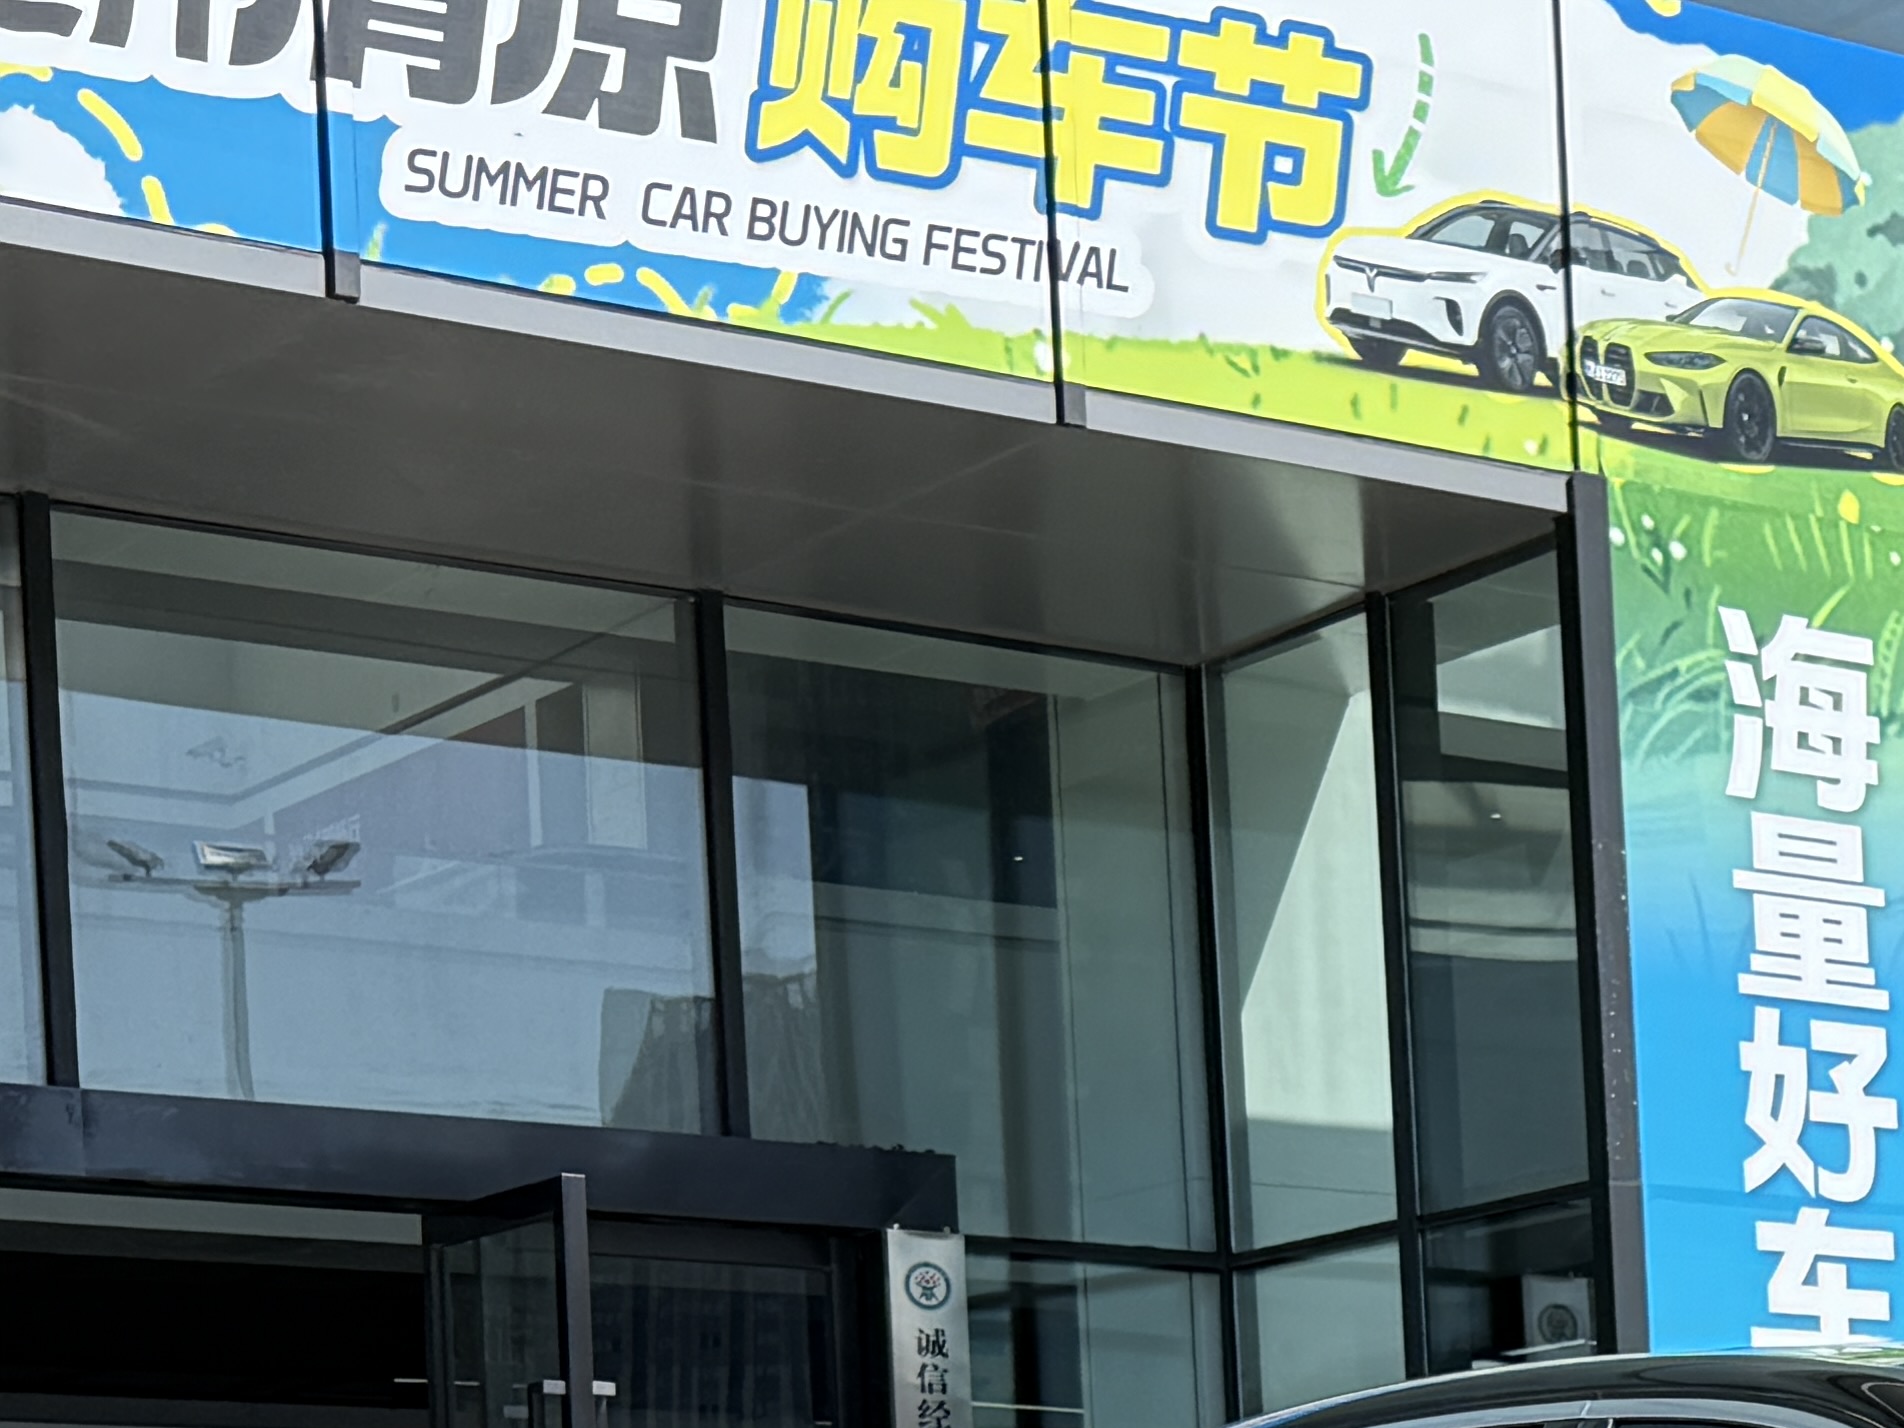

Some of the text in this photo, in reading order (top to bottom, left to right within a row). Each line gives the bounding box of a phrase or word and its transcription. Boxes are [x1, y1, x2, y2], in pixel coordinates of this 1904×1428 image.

[404, 147, 1131, 294] SUMMER CAR BUYING FESTIVAL
[1717, 604, 1899, 1348] 海量好车
